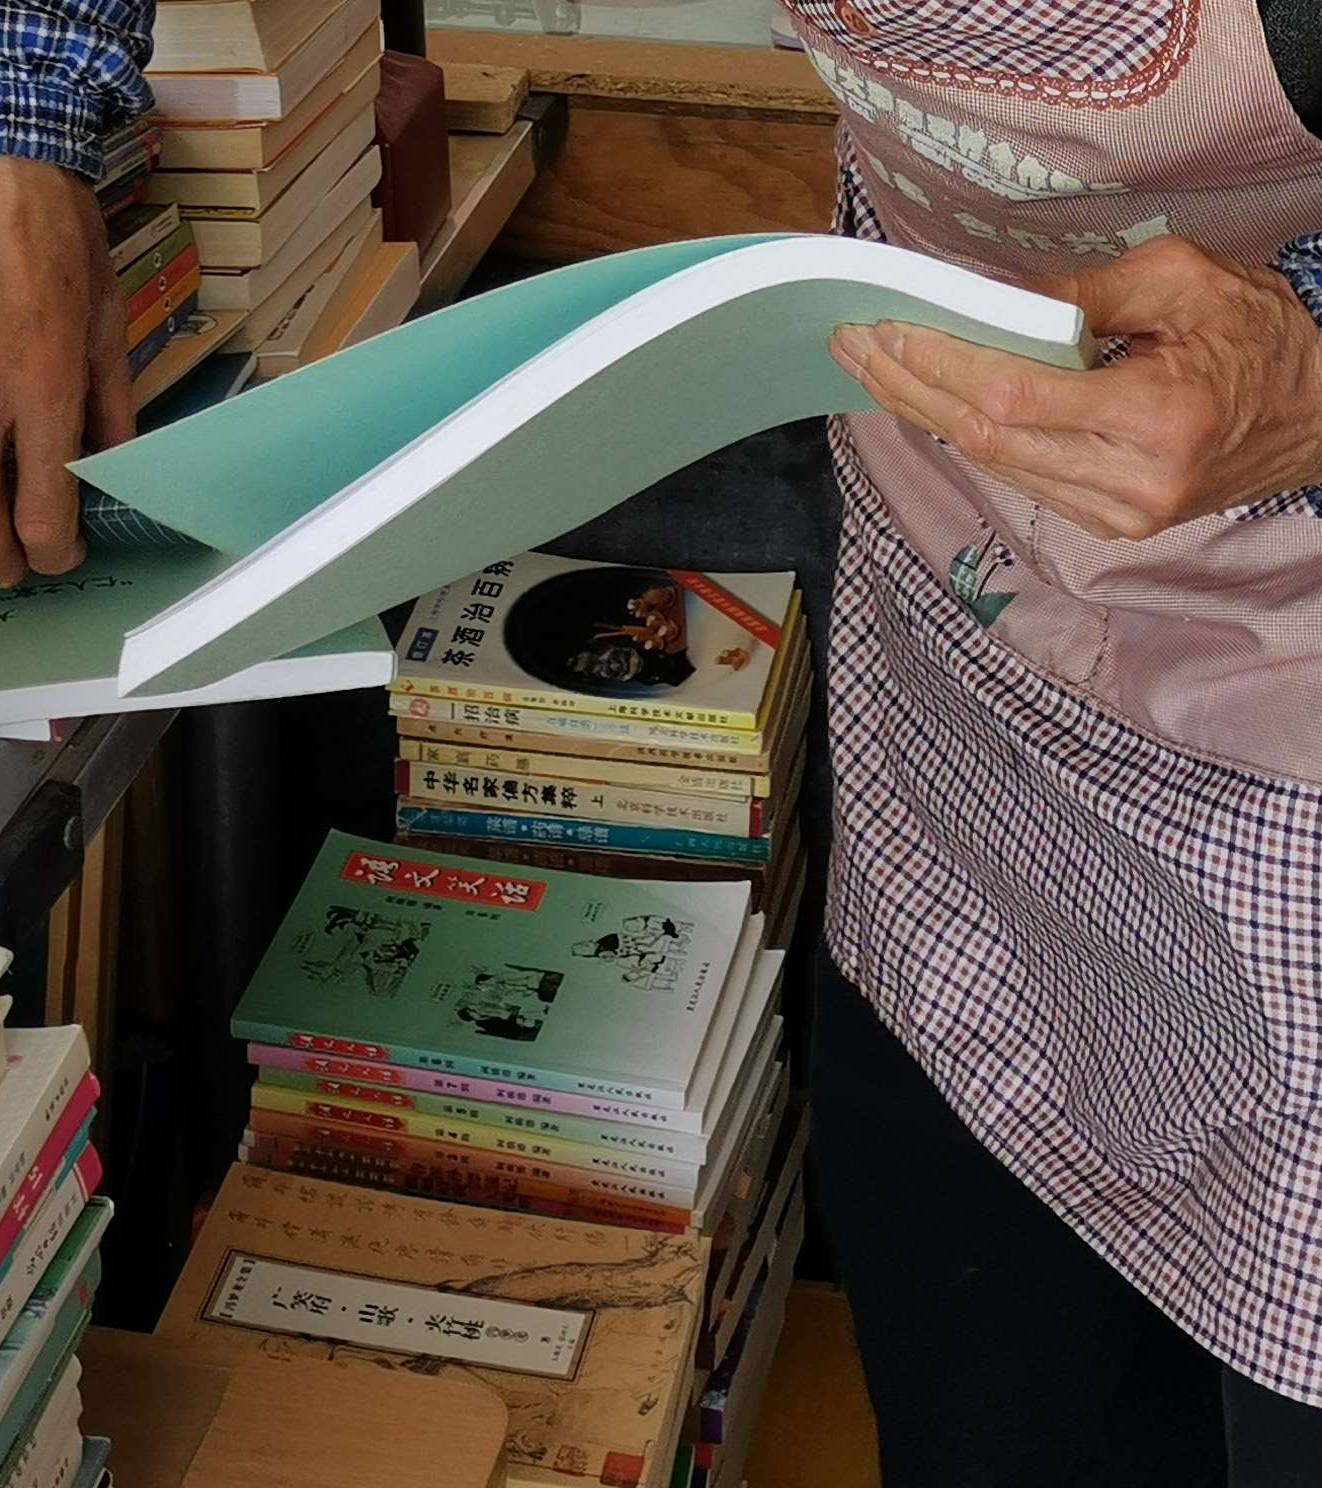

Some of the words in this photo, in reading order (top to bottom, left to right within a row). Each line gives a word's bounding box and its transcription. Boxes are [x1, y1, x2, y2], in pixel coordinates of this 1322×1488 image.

[450, 702, 520, 726] 一招治病
[590, 795, 604, 809] 上
[353, 856, 533, 906] 语文笑话
